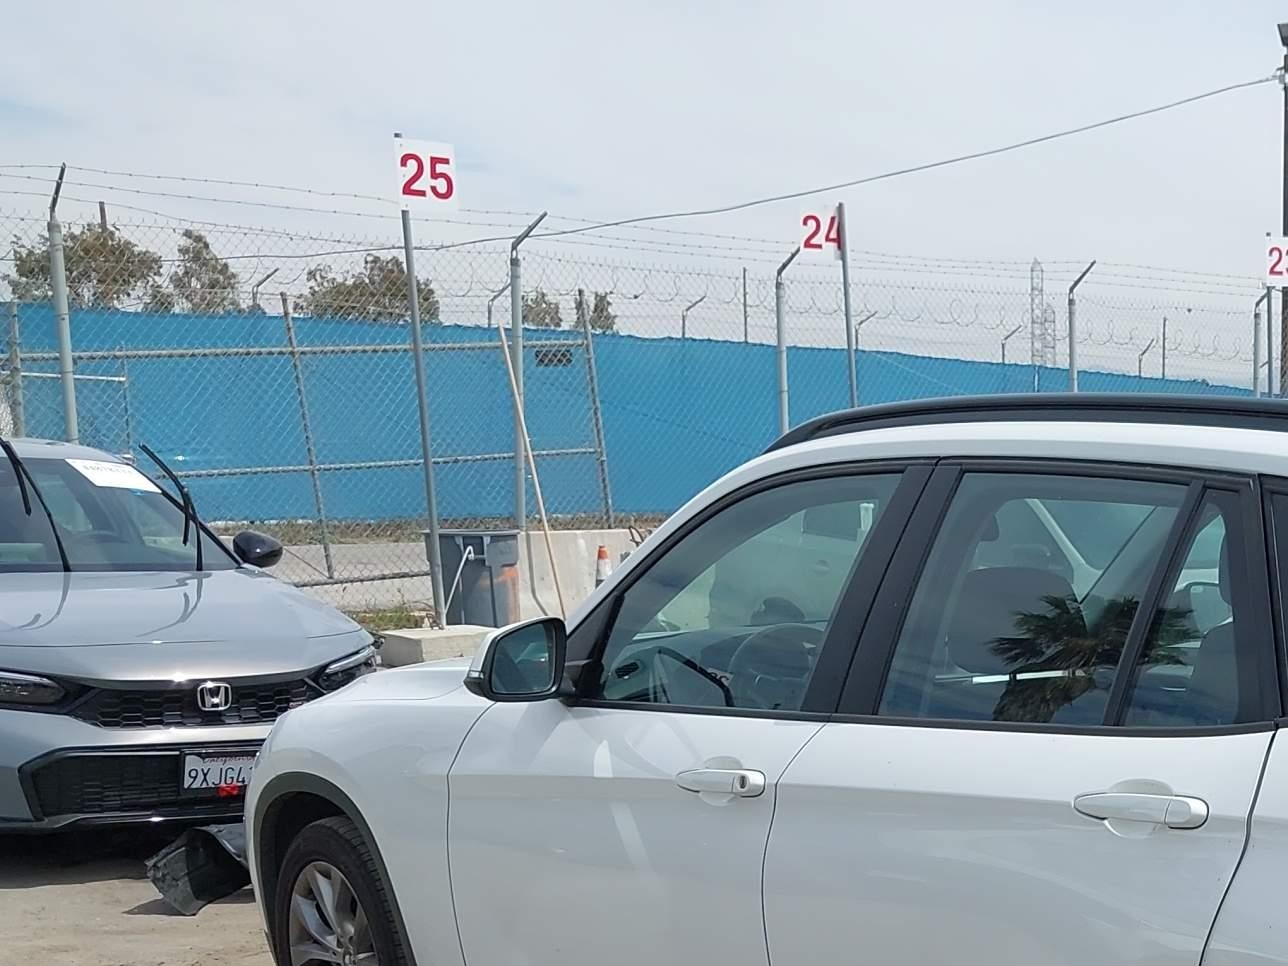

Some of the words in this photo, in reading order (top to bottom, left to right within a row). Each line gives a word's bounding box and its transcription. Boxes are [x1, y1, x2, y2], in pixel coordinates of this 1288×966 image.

[399, 153, 454, 200] 25
[802, 215, 842, 251] 24
[188, 766, 254, 789] 9XJG4
